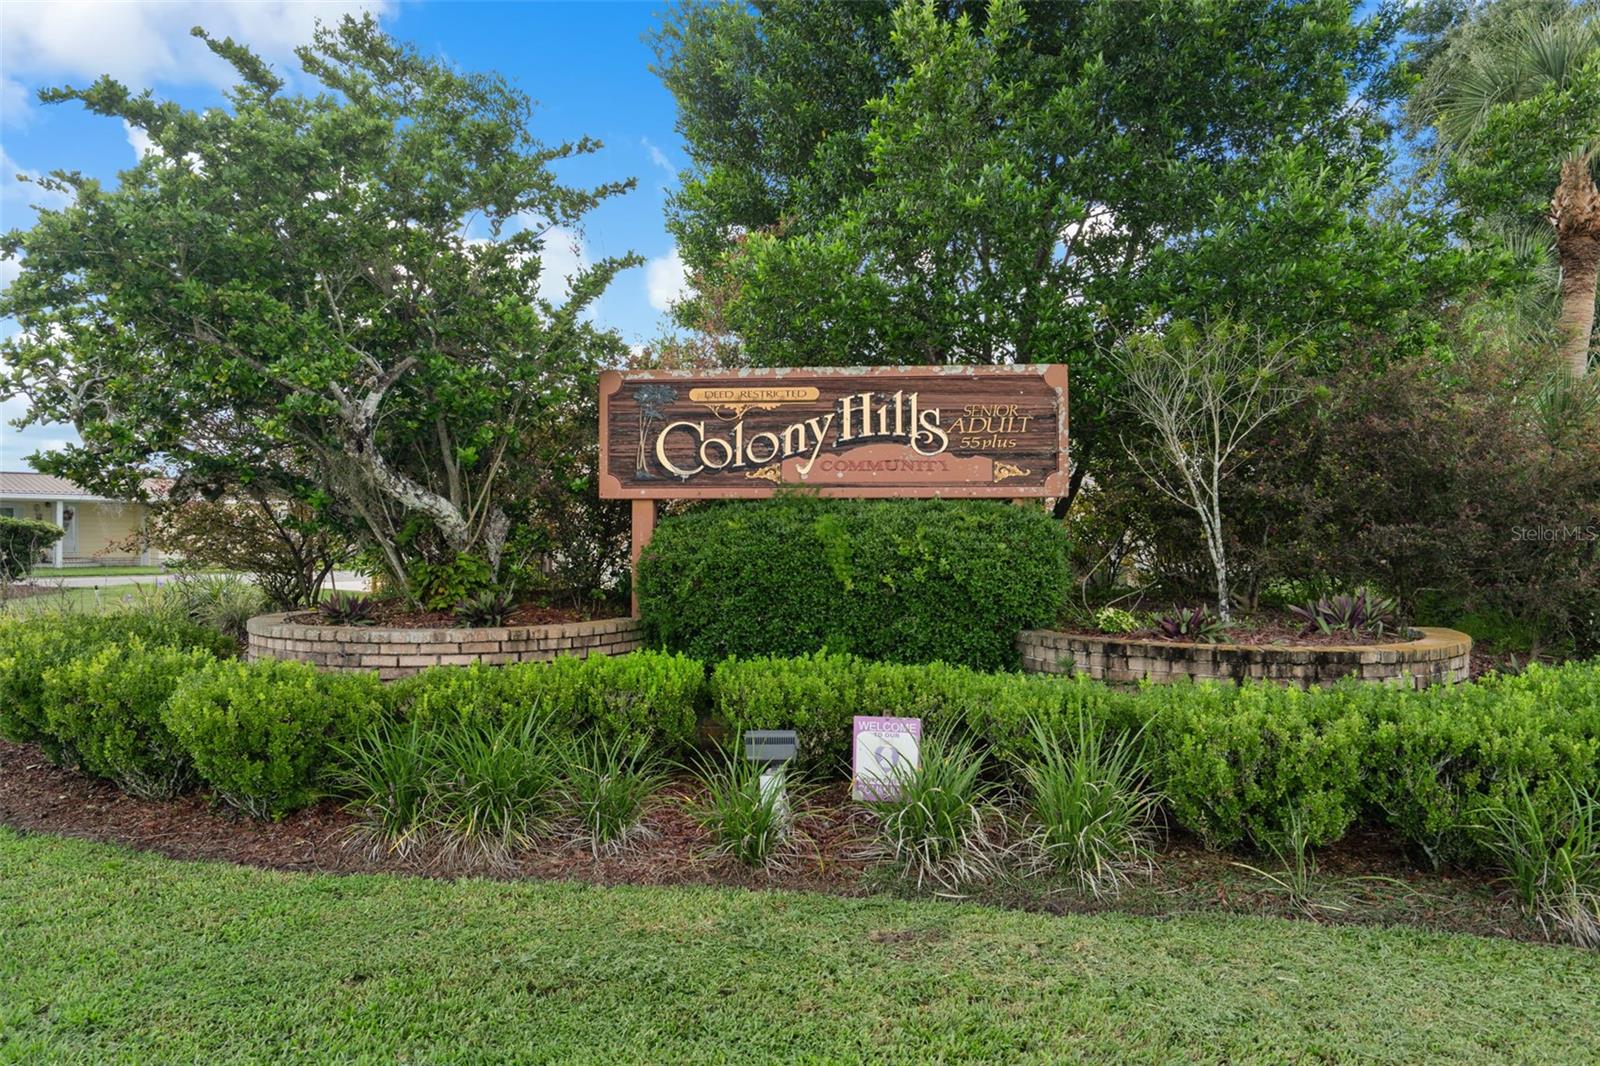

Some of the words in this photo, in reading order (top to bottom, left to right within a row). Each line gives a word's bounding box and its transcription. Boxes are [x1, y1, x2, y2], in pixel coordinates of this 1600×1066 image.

[704, 390, 734, 399] DEED
[739, 389, 807, 399] RESTRICTED
[963, 404, 1019, 417] SENIOR
[947, 416, 1034, 434] ADULT
[656, 413, 835, 475] Colony
[838, 389, 949, 456] Hills
[820, 459, 950, 472] COMMUNITY
[858, 721, 917, 733] WELCOME
